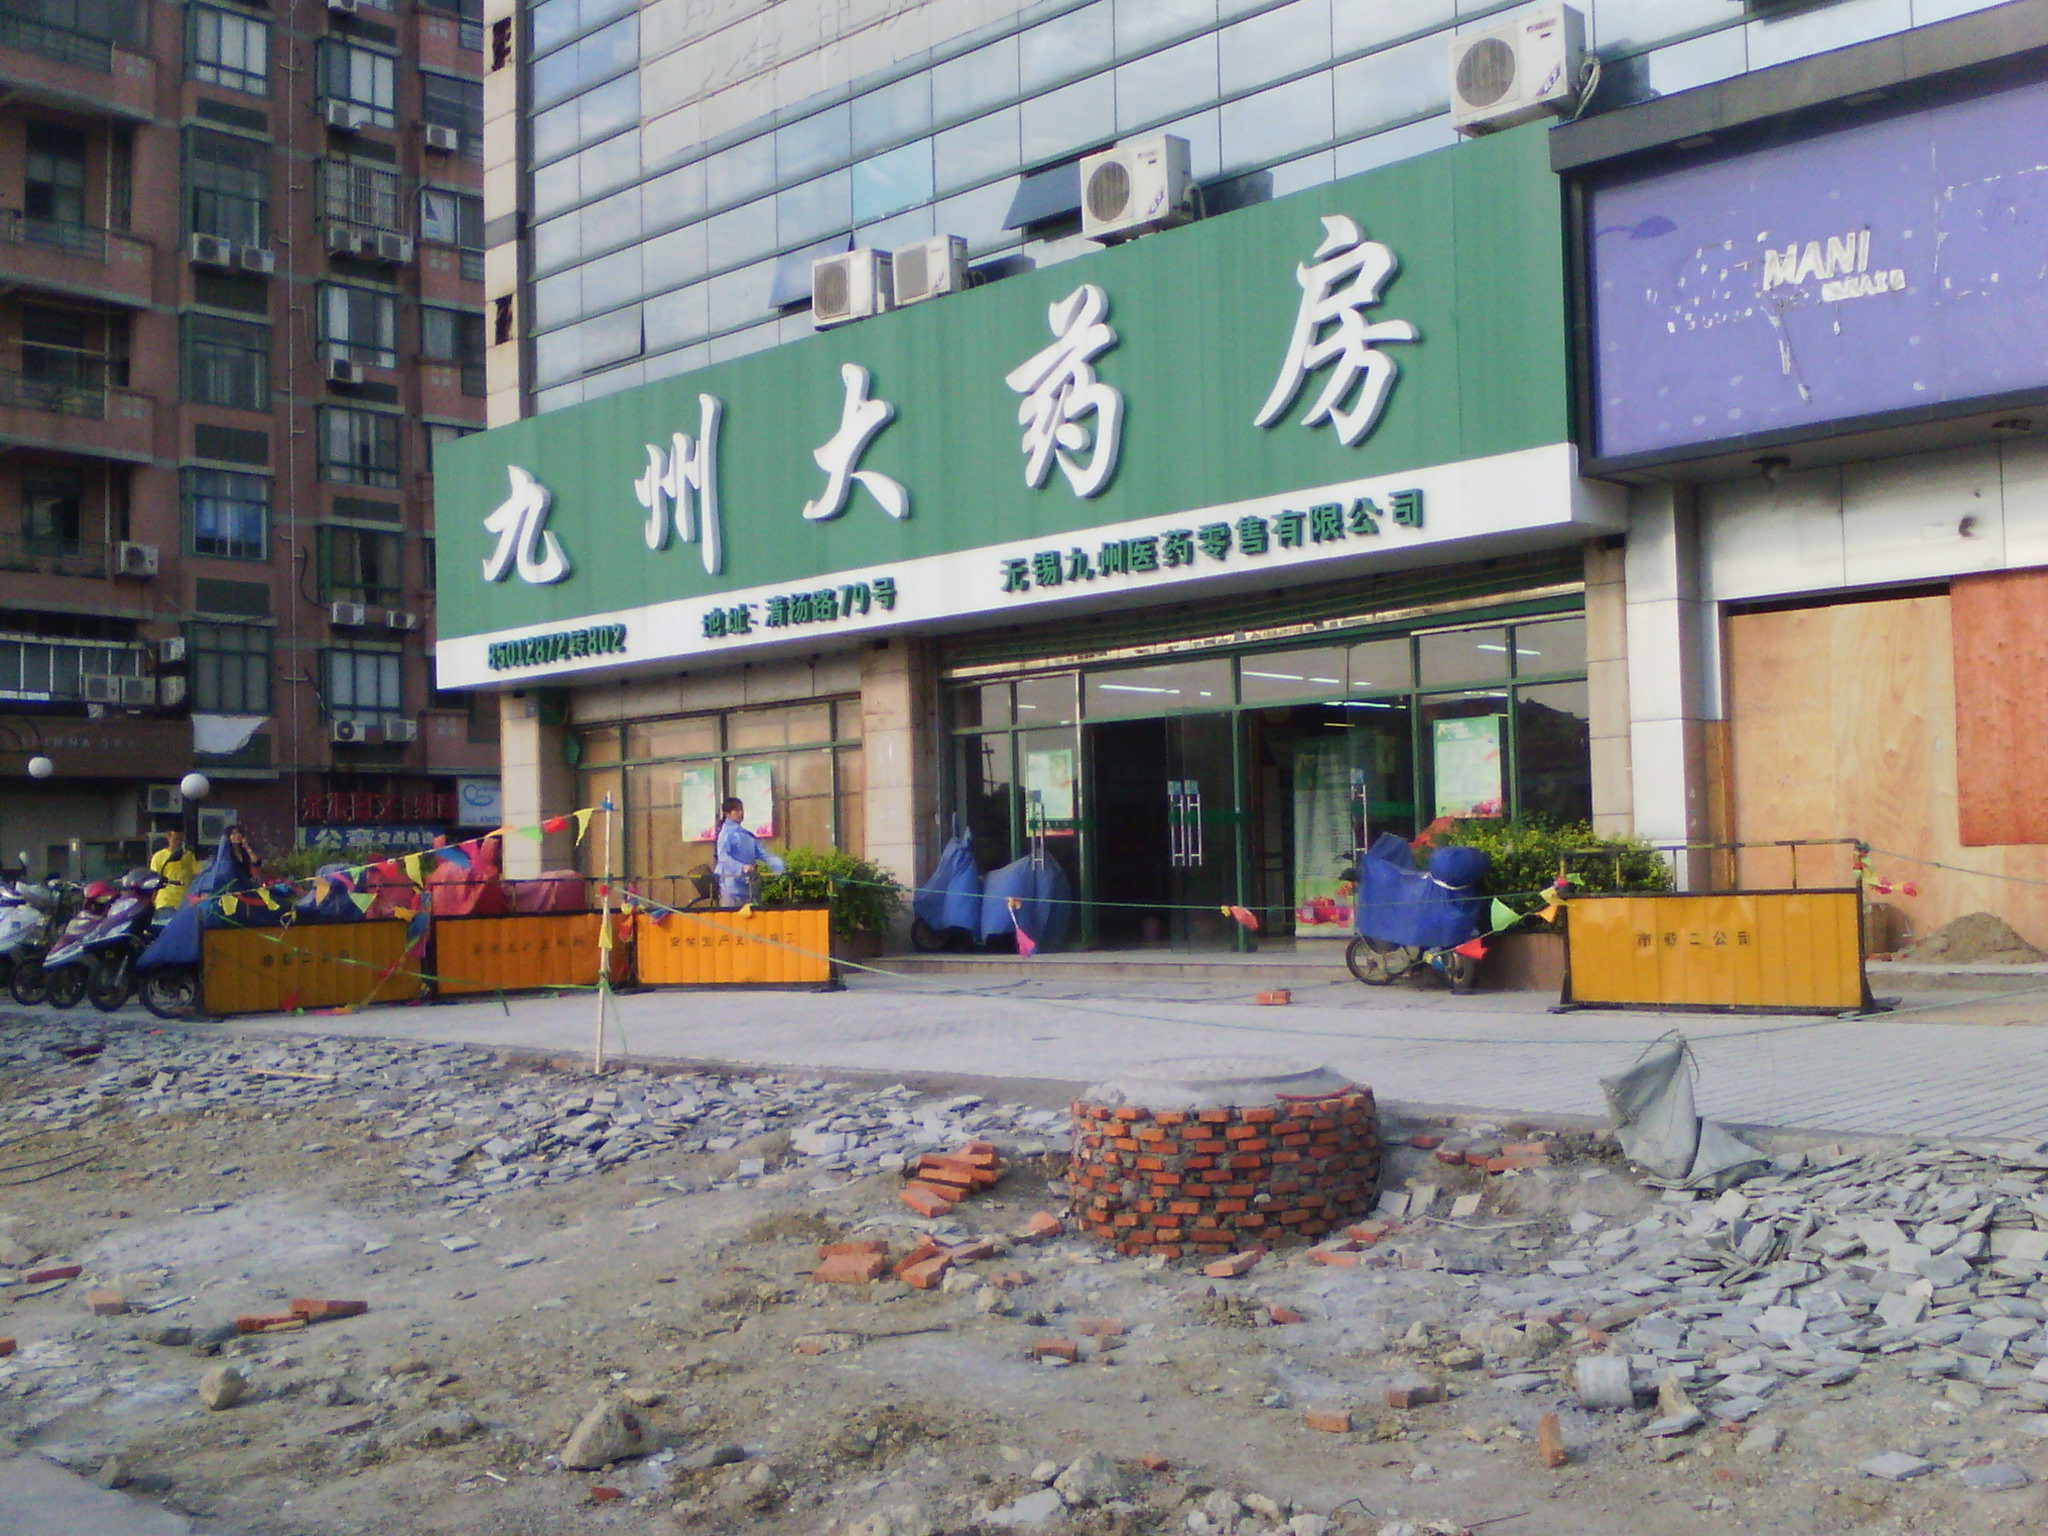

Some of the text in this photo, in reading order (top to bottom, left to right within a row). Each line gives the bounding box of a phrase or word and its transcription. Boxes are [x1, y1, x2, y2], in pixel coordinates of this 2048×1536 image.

[482, 213, 1421, 584] 九州大药房
[1001, 488, 1424, 593] 无锡九州医药零售有限公司
